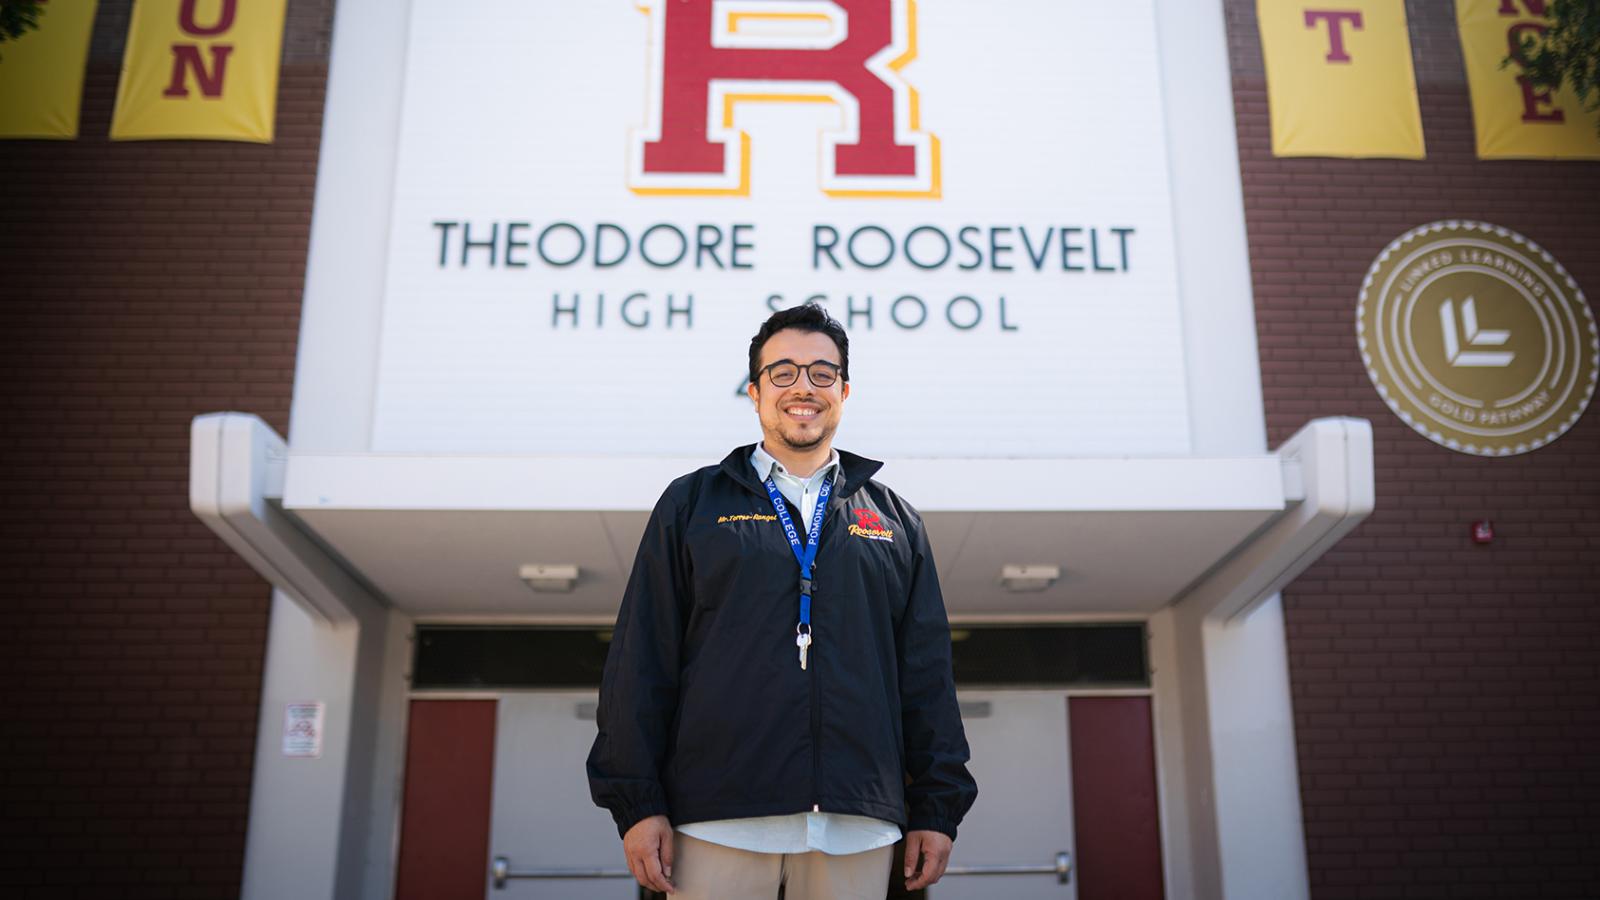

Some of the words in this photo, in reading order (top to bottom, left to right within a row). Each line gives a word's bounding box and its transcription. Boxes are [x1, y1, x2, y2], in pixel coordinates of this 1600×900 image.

[1303, 9, 1364, 64] T
[627, 0, 943, 199] R
[433, 222, 755, 269] THEODORE
[813, 225, 1136, 273] ROOSEVELT
[1400, 251, 1453, 292] LINKED
[1460, 249, 1545, 297] LEARNING
[551, 292, 695, 330] HIGH
[1429, 394, 1475, 422] GOLD
[1479, 390, 1549, 424] PATHWAY
[773, 497, 800, 546] COLLEGE
[808, 502, 824, 546] POMONA
[848, 523, 893, 538] Roosevelt
